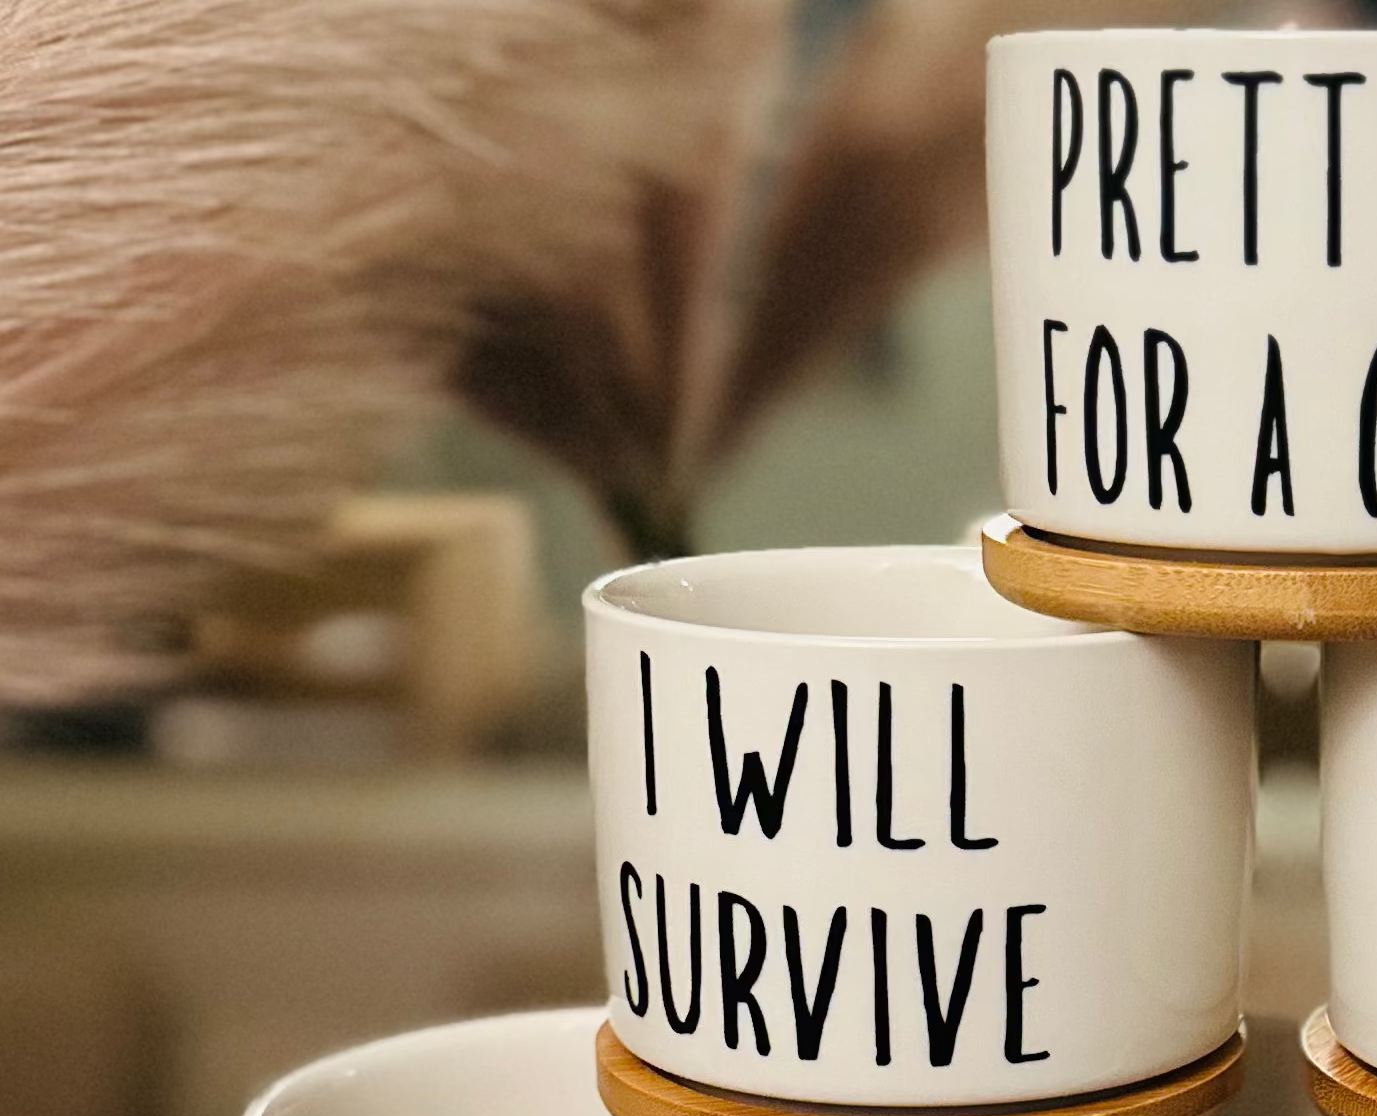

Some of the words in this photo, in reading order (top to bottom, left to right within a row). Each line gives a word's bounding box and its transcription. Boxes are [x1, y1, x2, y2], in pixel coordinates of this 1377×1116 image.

[1043, 318, 1193, 514] FOR
[1250, 334, 1295, 517] A
[639, 650, 658, 816] I
[705, 665, 999, 851] WILL
[619, 860, 1051, 1068] SURVIVE
